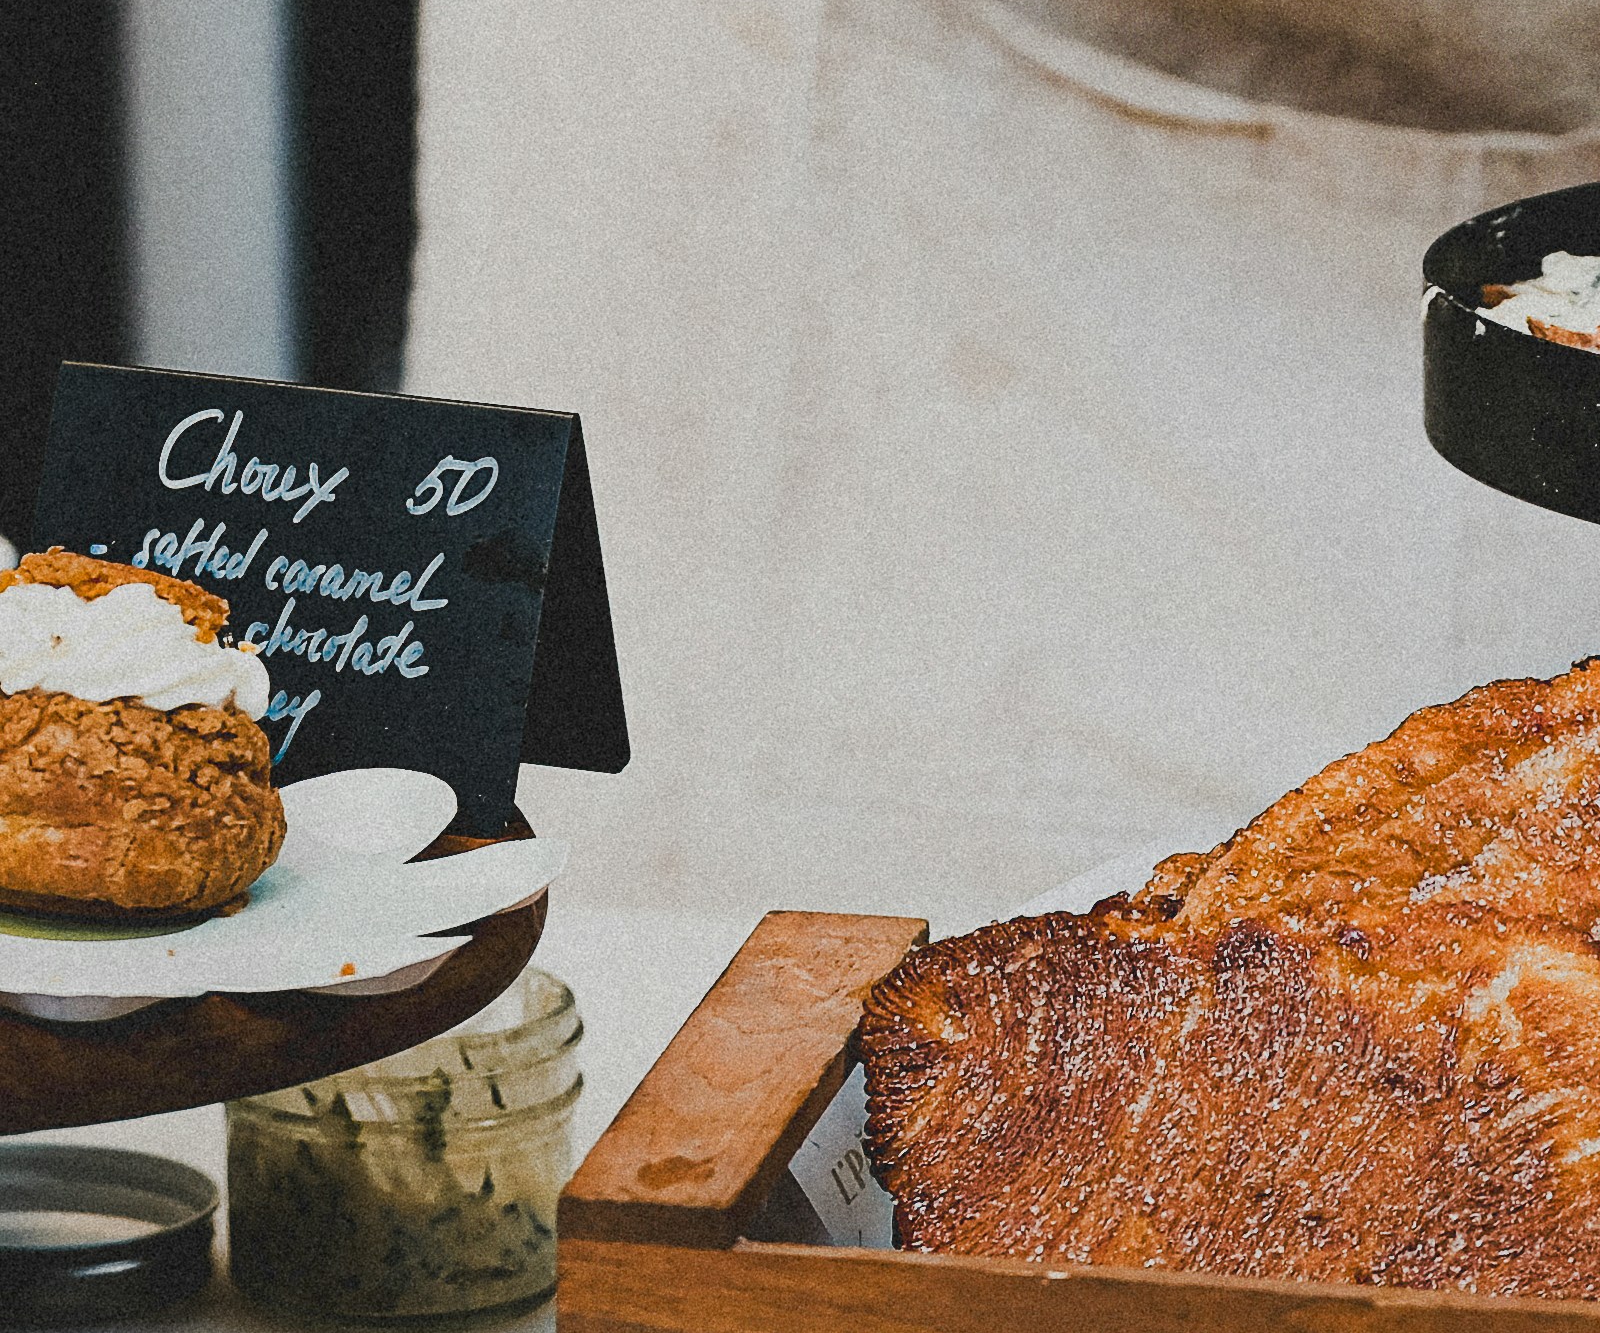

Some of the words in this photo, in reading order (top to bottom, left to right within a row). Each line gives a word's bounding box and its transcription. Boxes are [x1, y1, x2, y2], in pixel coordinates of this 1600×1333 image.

[158, 409, 350, 523] Choux
[405, 455, 500, 517] 50
[131, 518, 269, 581] salted
[265, 553, 449, 611] caramel
[244, 598, 430, 679] chocolate
